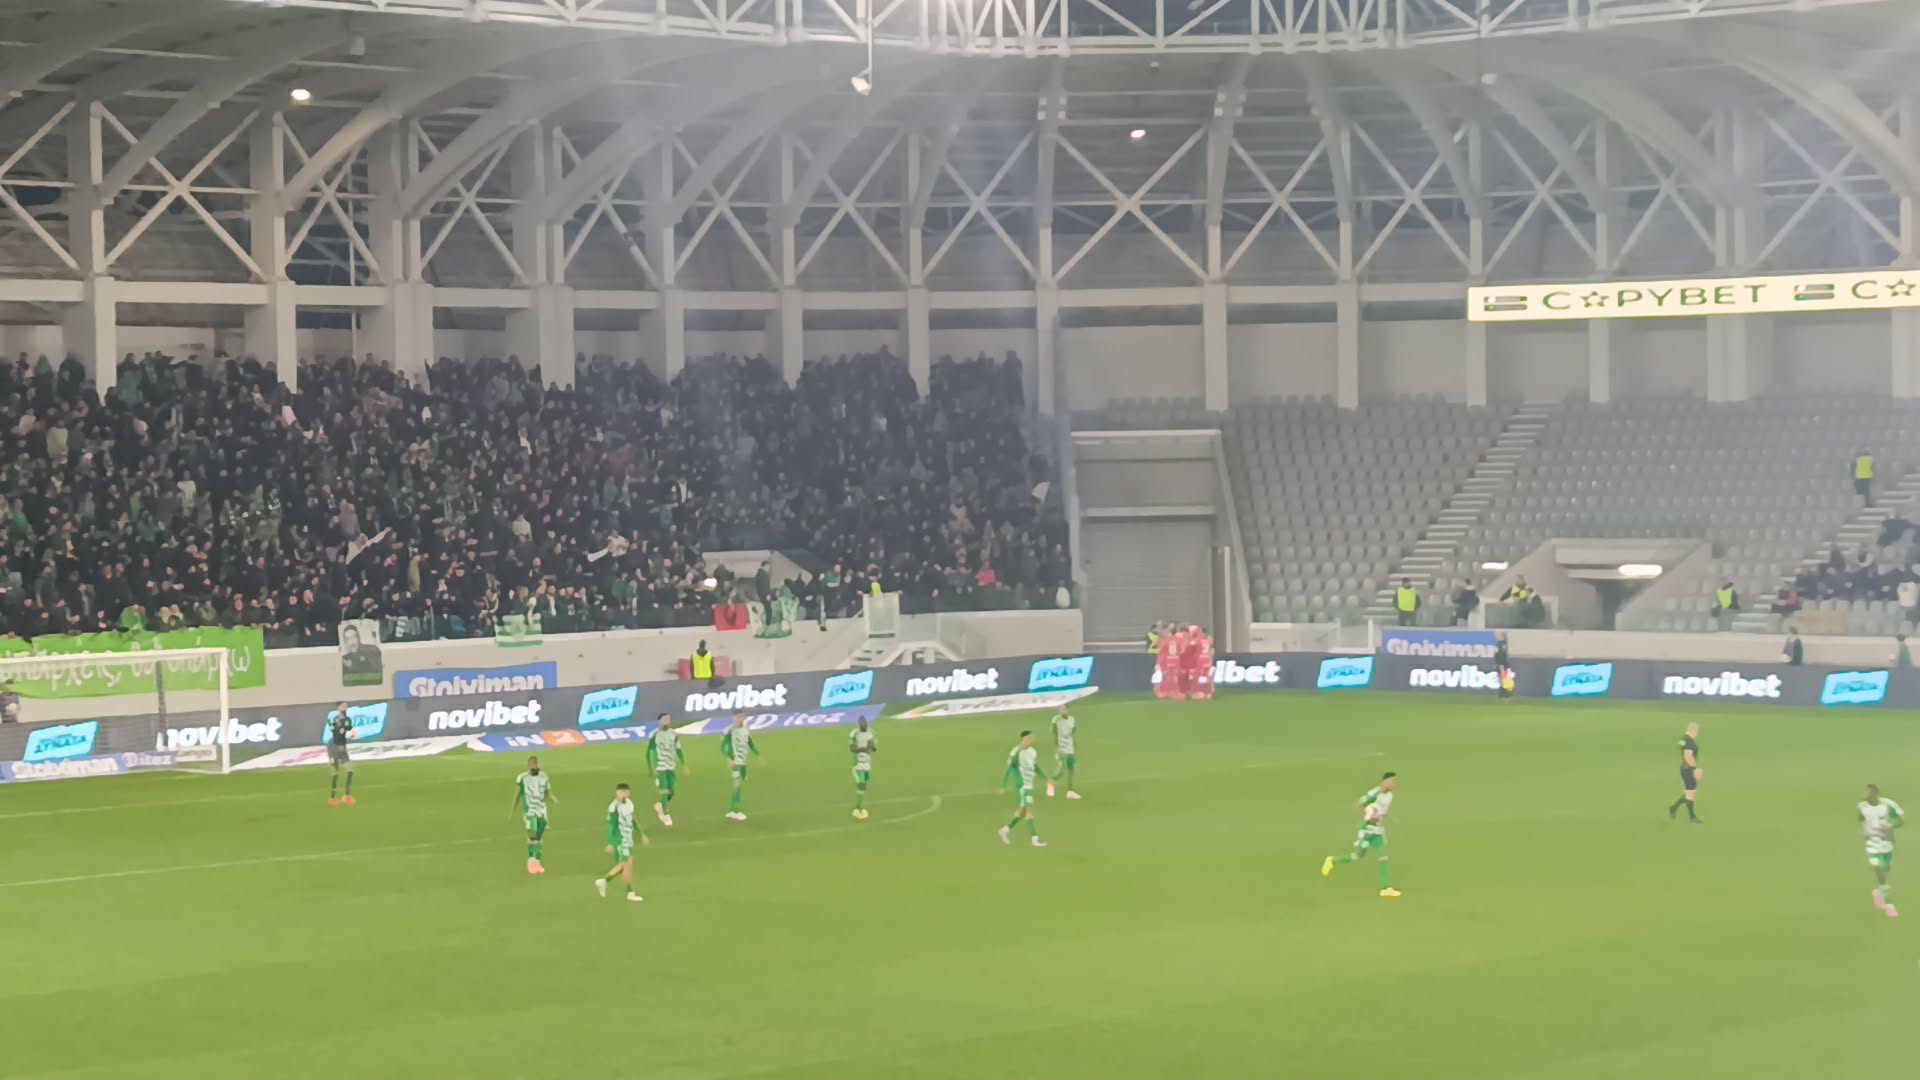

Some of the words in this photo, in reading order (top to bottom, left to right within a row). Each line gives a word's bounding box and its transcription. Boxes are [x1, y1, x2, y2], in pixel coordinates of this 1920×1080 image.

[906, 667, 999, 697] novibet
[1410, 664, 1514, 689] novibe
[1662, 671, 1781, 697] novibet
[685, 683, 788, 712] novibet
[428, 699, 541, 730] novibet
